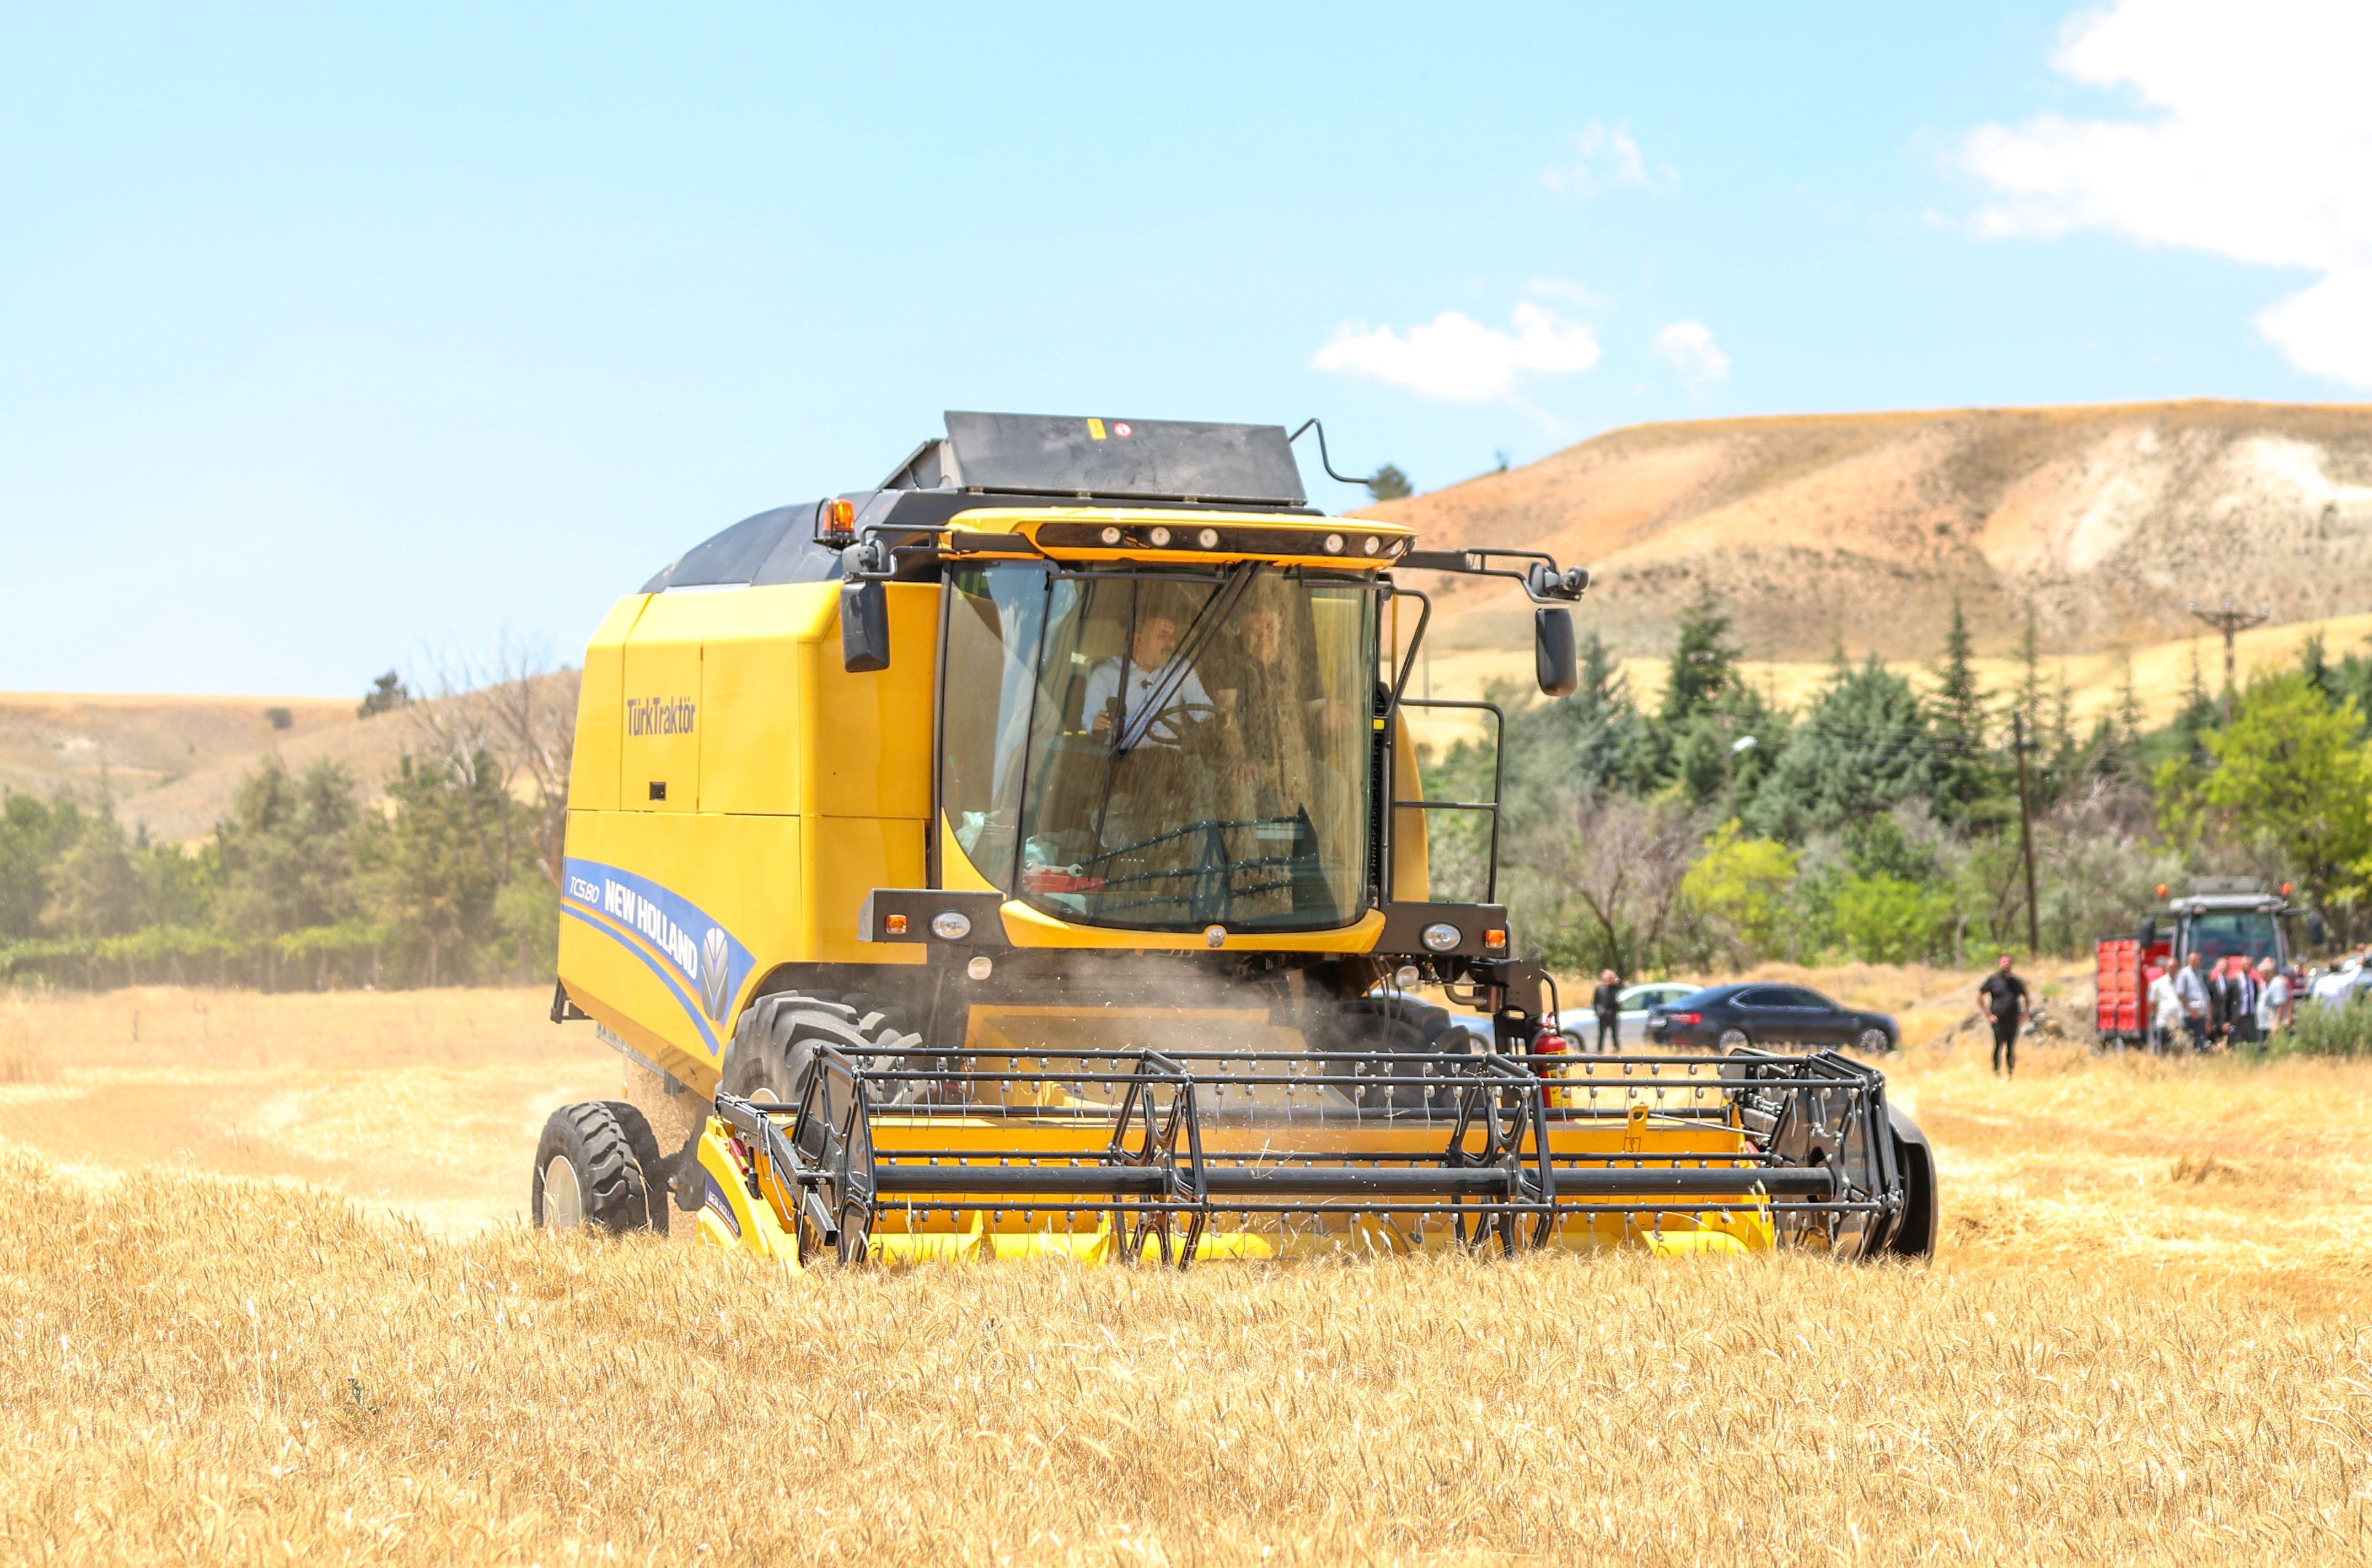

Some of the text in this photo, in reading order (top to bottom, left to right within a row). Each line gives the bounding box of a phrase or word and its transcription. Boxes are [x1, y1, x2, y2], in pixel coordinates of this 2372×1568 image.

[627, 695, 695, 736] TürkTraktör
[604, 878, 698, 980] NEW HOLLAND
